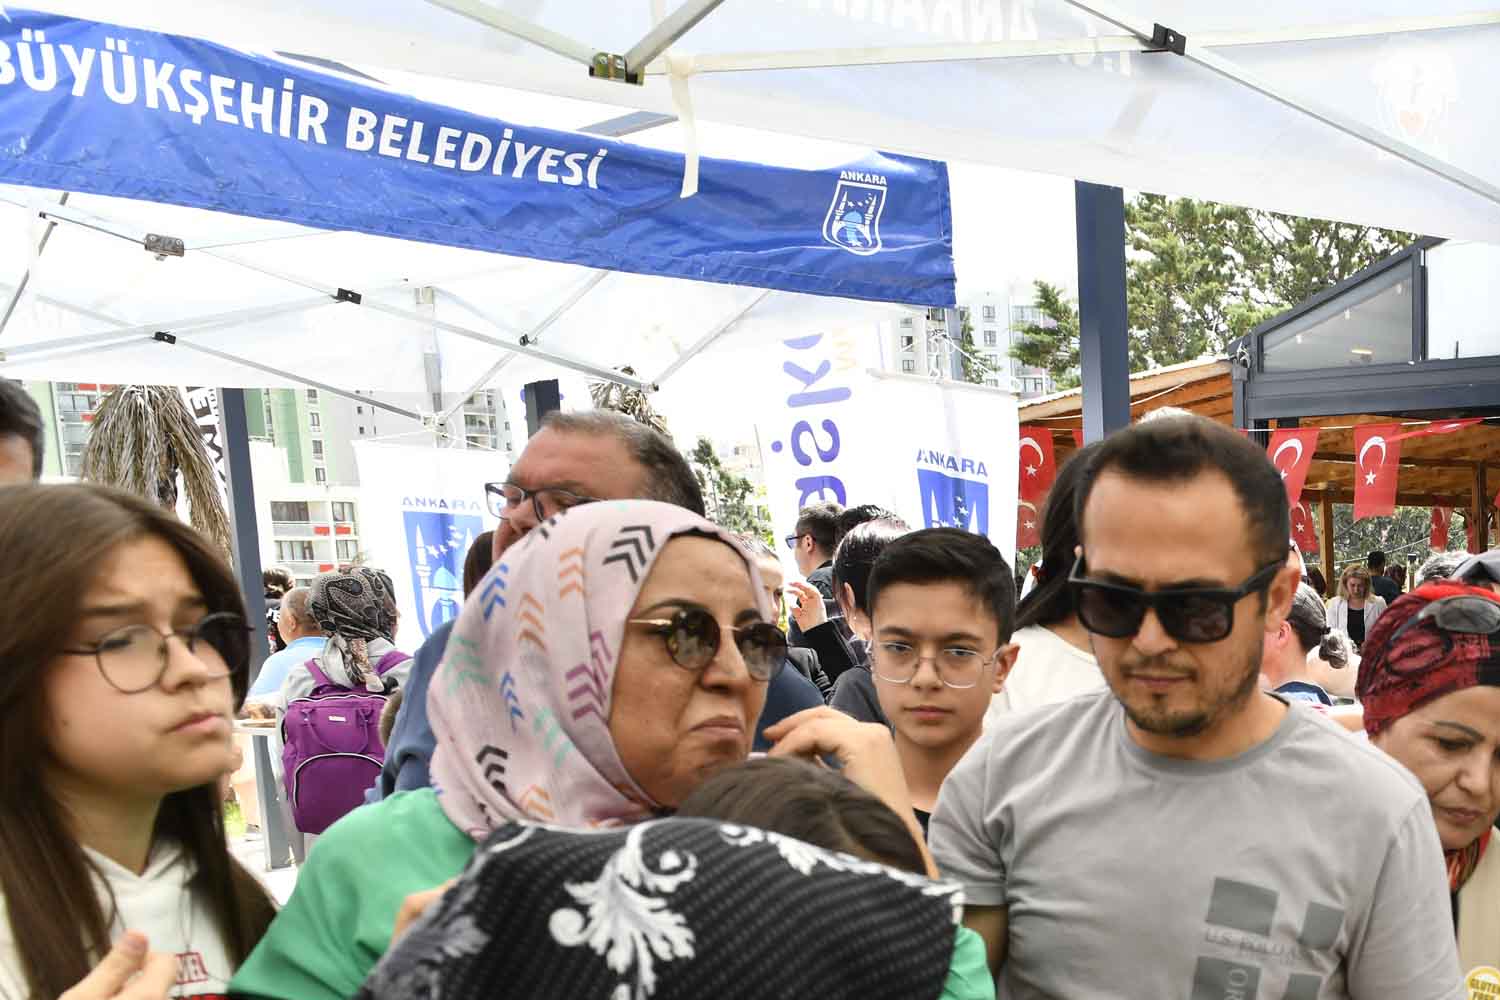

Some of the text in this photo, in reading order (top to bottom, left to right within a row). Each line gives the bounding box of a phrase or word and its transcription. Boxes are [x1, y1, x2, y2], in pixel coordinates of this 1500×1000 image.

[346, 107, 608, 190] BELEDİYESİ
[840, 170, 887, 186] ANKARA
[915, 448, 989, 478] ANKARA
[401, 496, 481, 510] ANKARA
